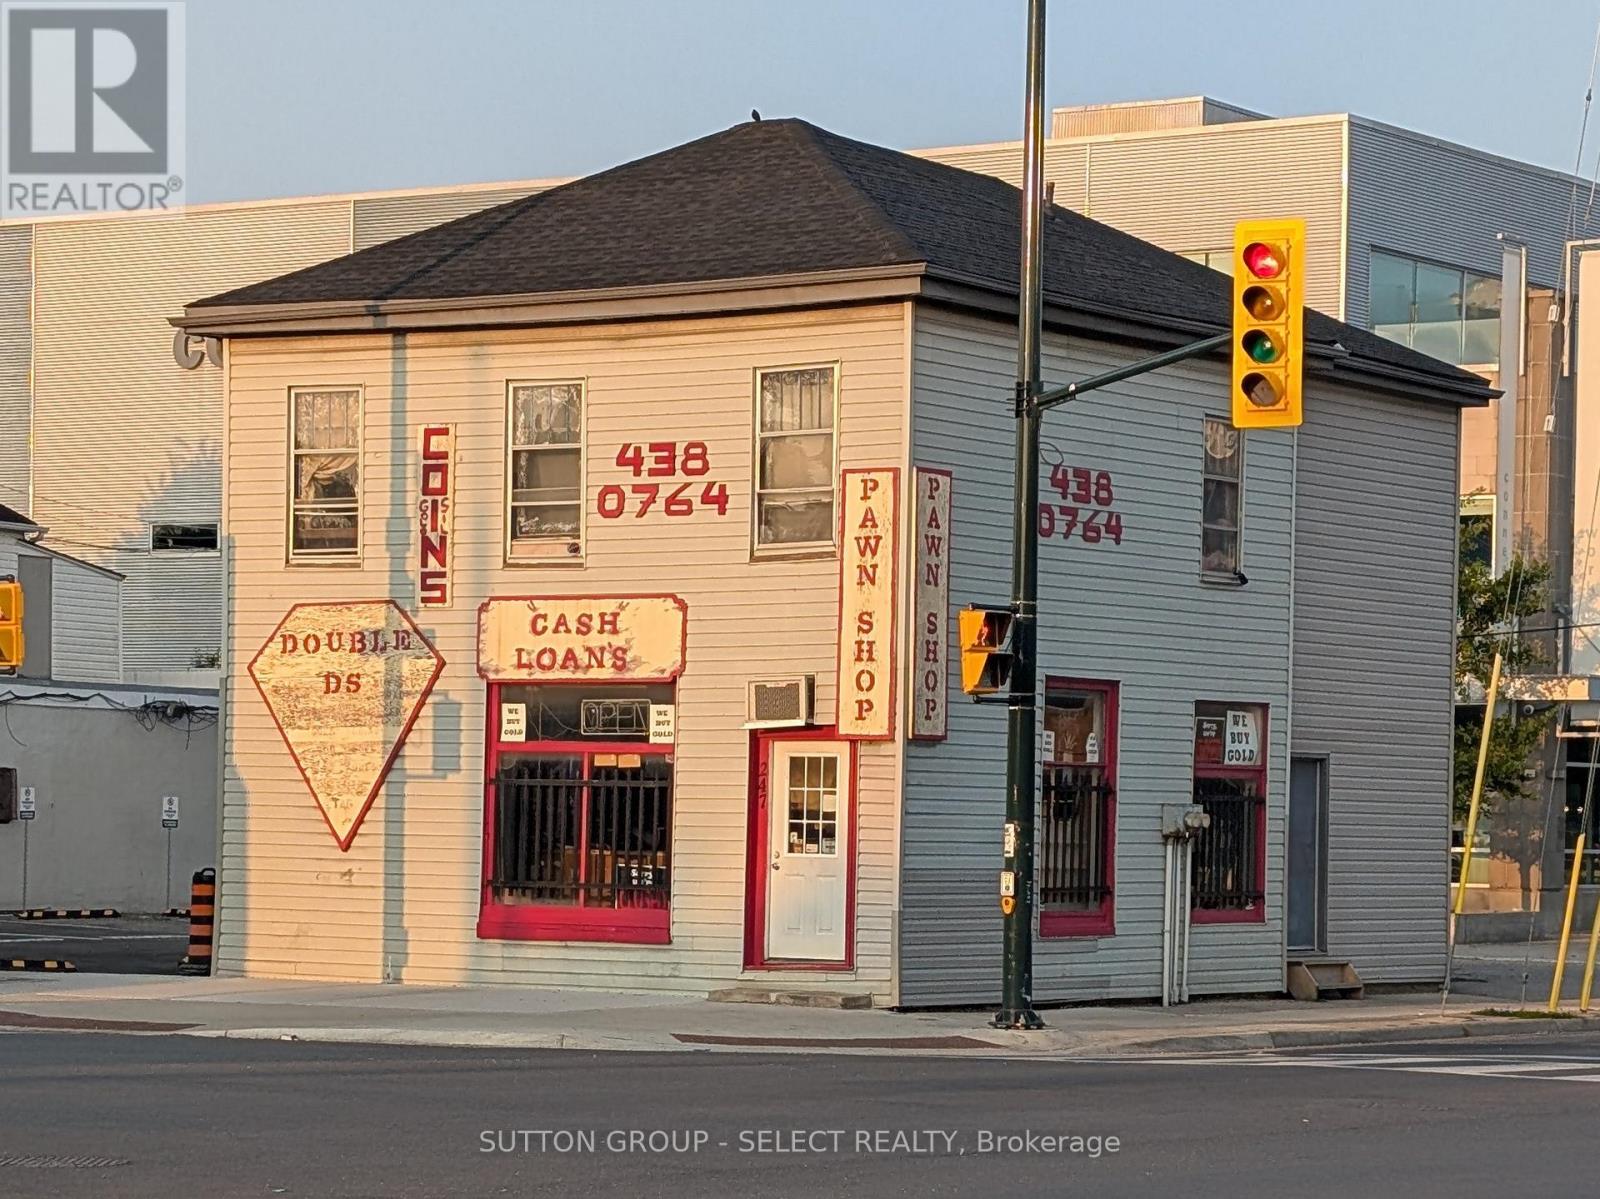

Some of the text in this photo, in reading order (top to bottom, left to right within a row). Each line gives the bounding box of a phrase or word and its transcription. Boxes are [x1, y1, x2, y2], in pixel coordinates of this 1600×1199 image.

[616, 441, 710, 477] 438
[597, 481, 730, 519] 0764
[1050, 464, 1114, 507] 438
[420, 427, 450, 604] COINS
[854, 477, 883, 587] PAWN
[924, 476, 943, 588] PAWN
[1038, 502, 1123, 546] 0764
[280, 629, 412, 655] DOUBLE
[515, 641, 629, 673] LOAN'S
[323, 671, 362, 695] DS
[854, 611, 877, 721] SHOP
[924, 612, 940, 721] SHOP
[507, 707, 519, 715] WE
[583, 702, 649, 733] OPEN
[1232, 714, 1248, 728] WE
[1227, 749, 1255, 762] GOLD
[1230, 731, 1250, 745] BUY
